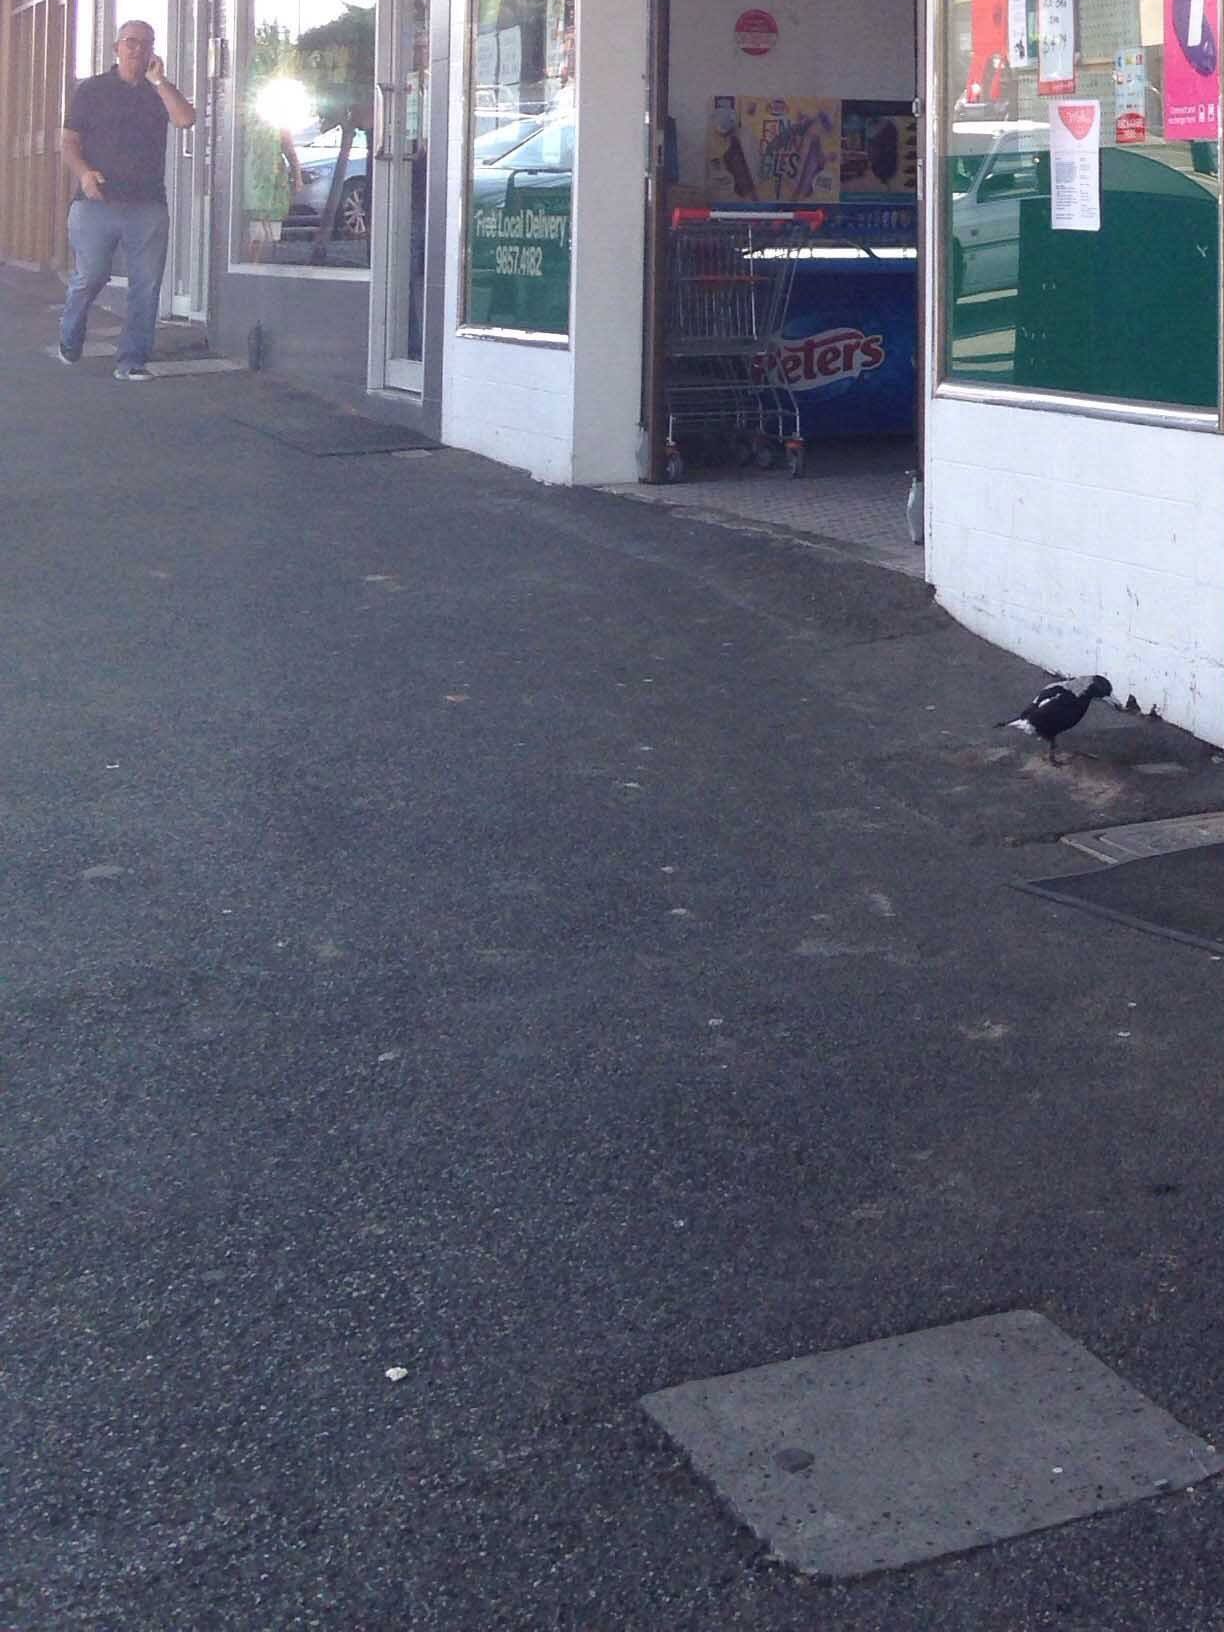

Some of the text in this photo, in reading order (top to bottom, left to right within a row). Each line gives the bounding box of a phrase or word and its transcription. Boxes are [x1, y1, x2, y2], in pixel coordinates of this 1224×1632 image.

[476, 208, 567, 246] Free Local Delivery
